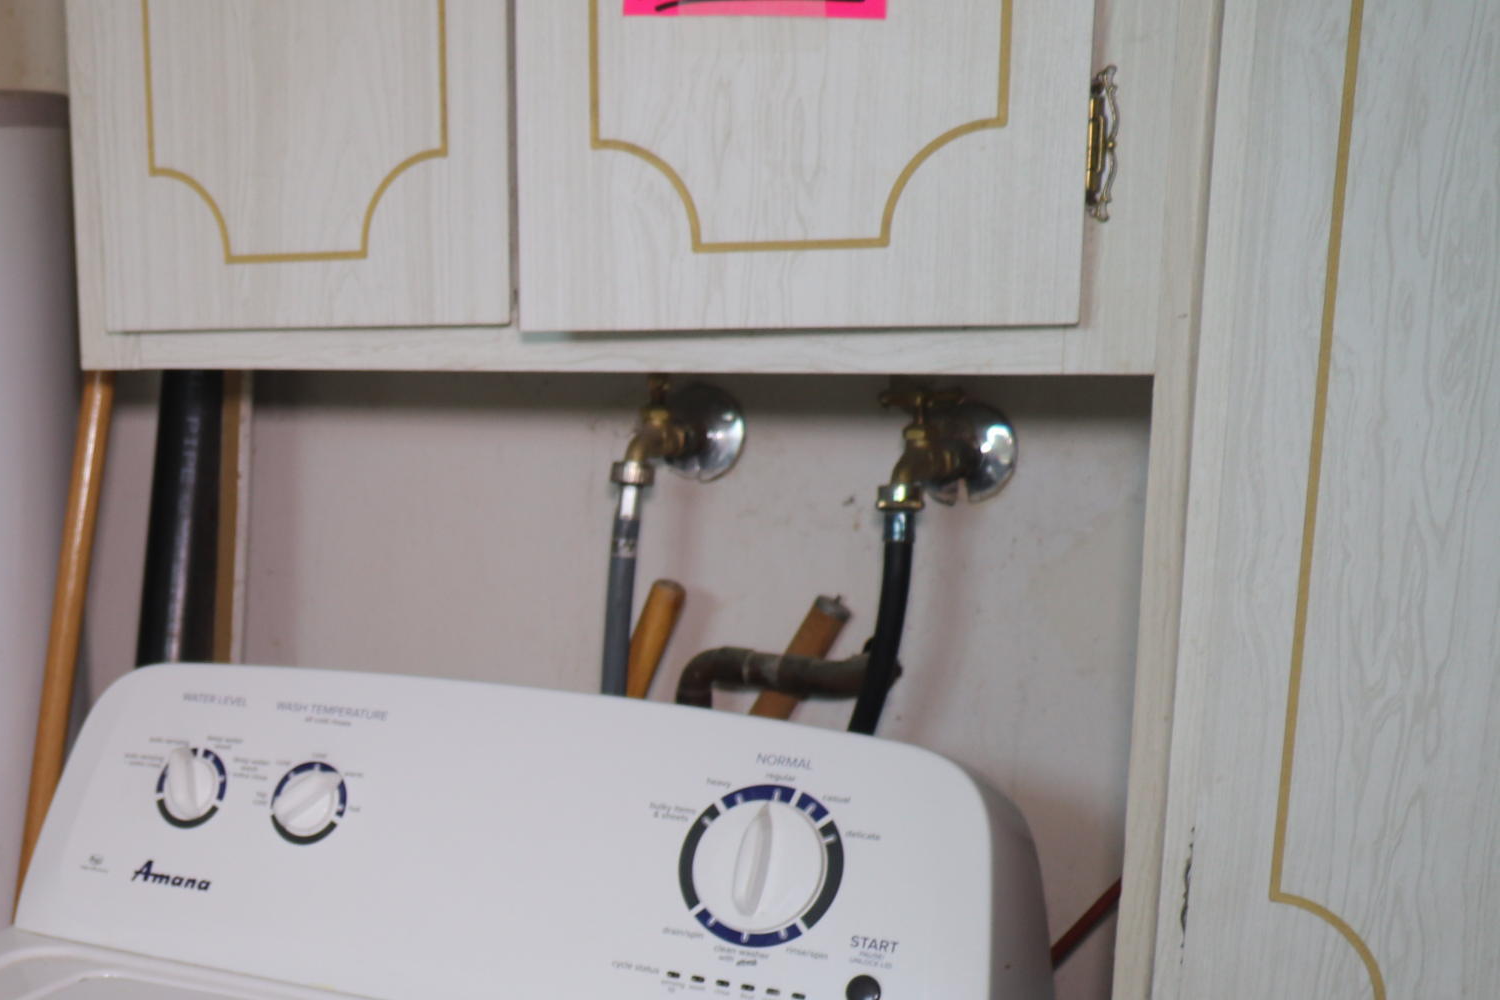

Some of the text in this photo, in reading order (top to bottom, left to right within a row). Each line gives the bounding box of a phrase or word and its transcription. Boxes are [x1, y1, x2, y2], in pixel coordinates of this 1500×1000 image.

[218, 696, 247, 707] LEVEL
[276, 701, 389, 721] WASH TEMPERATURE
[756, 752, 813, 770] NORMAL
[706, 776, 732, 789] heavy
[845, 830, 881, 841] delicate
[131, 859, 211, 891] Amana
[850, 935, 899, 953] START
